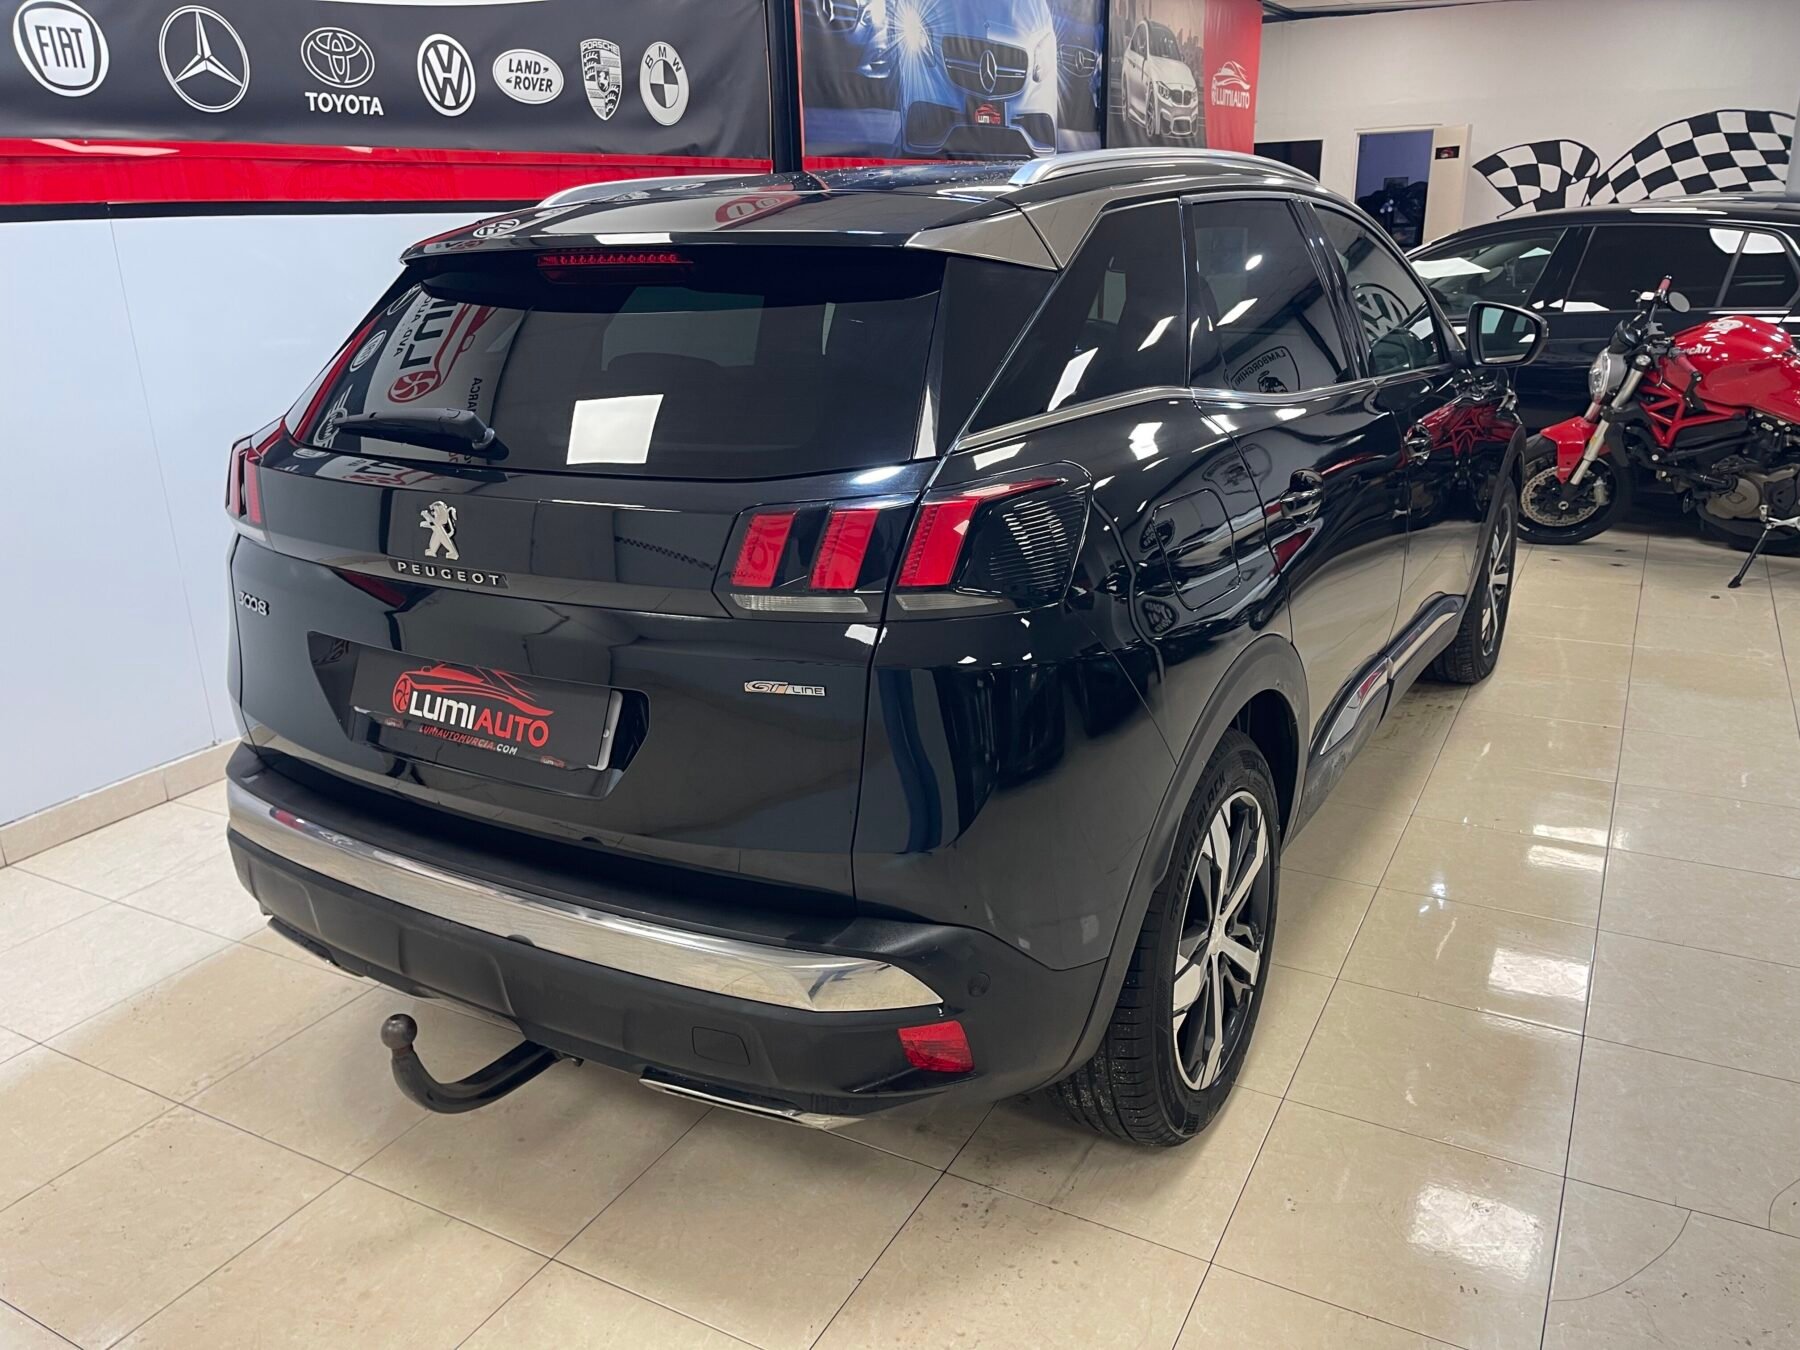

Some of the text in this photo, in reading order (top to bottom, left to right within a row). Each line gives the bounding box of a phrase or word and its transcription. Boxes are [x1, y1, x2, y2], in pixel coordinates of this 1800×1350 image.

[34, 25, 86, 69] FIAT
[582, 41, 619, 56] PORSCHE
[645, 46, 682, 73] BMW
[508, 58, 543, 75] LAND
[513, 77, 553, 93] ROVER
[305, 91, 385, 116] TOYOTA
[397, 561, 499, 586] PEUGEOT
[239, 591, 269, 616] 3008
[745, 680, 824, 695] GT LINE
[409, 690, 549, 748] LUMIAUTO
[418, 725, 518, 756] LUMIAUTOMURCIA.COM
